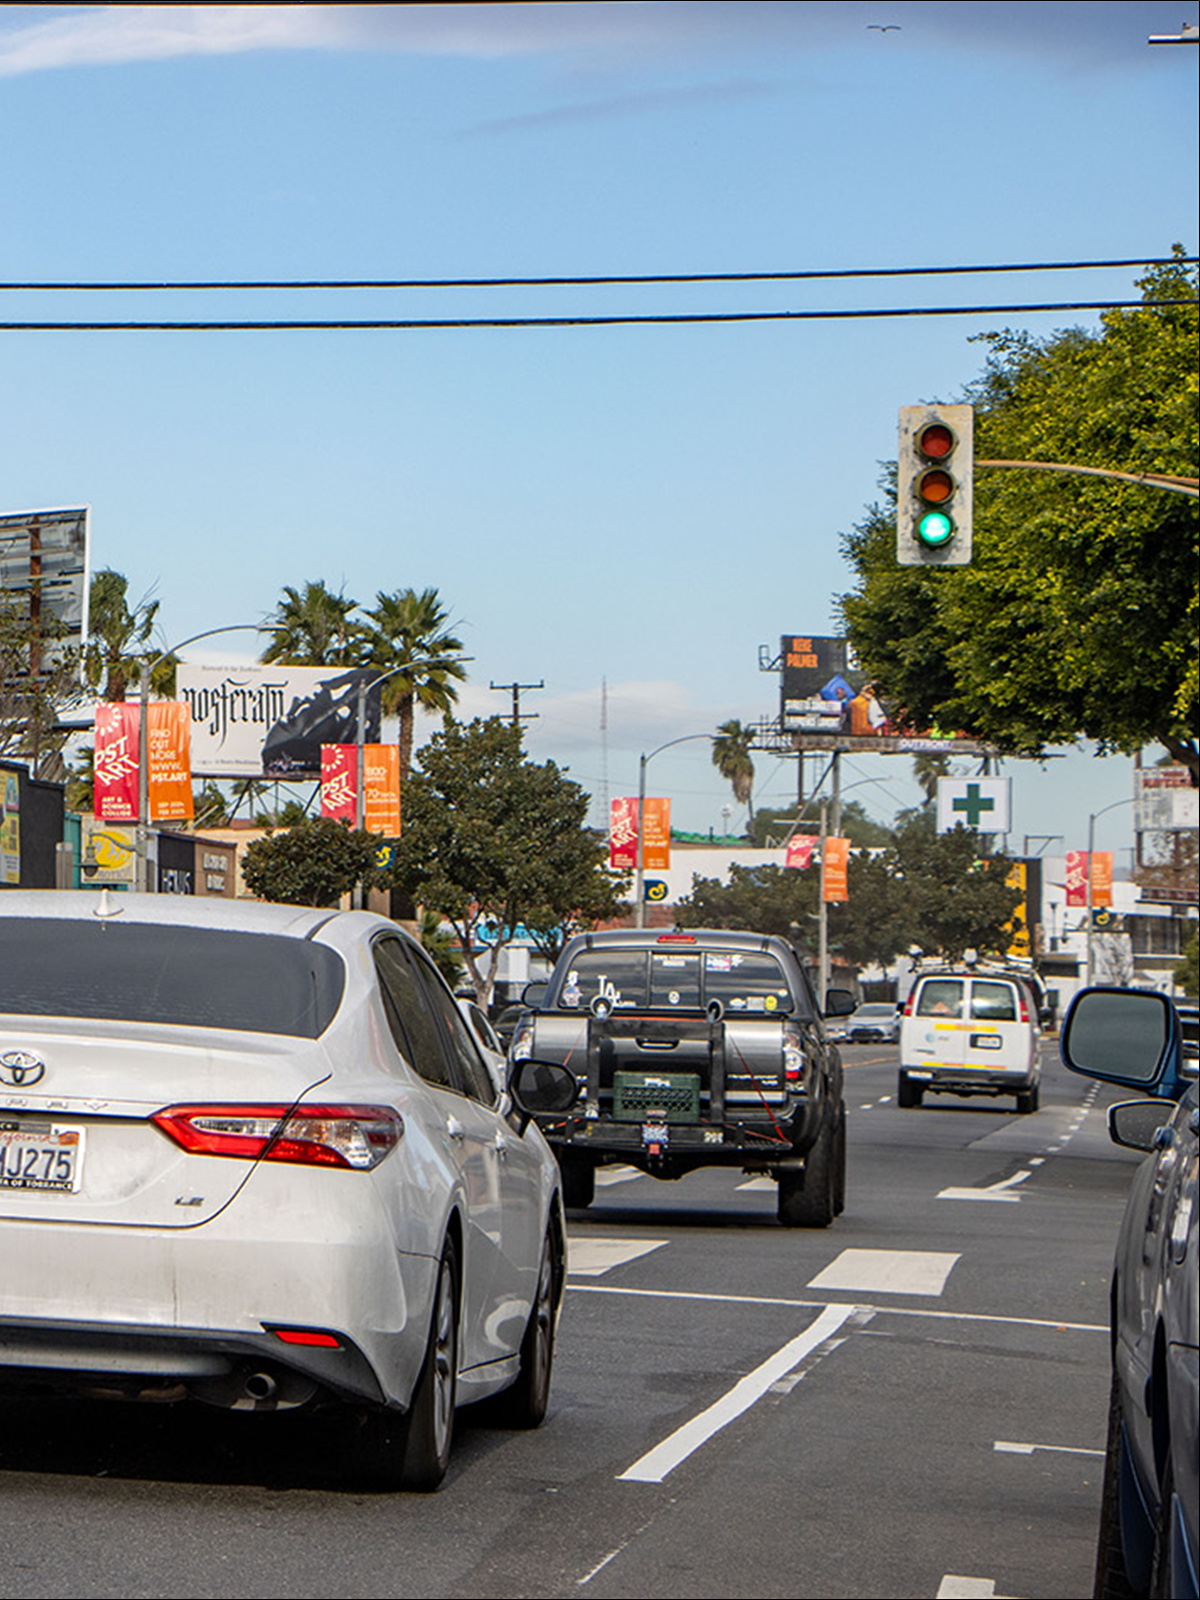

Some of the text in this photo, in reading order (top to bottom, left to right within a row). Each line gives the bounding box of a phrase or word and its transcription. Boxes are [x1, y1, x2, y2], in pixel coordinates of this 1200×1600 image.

[93, 735, 128, 771] PST
[95, 754, 139, 786] ART
[321, 771, 349, 798] PST
[323, 786, 357, 811] ART
[11, 1178, 23, 1187] OF
